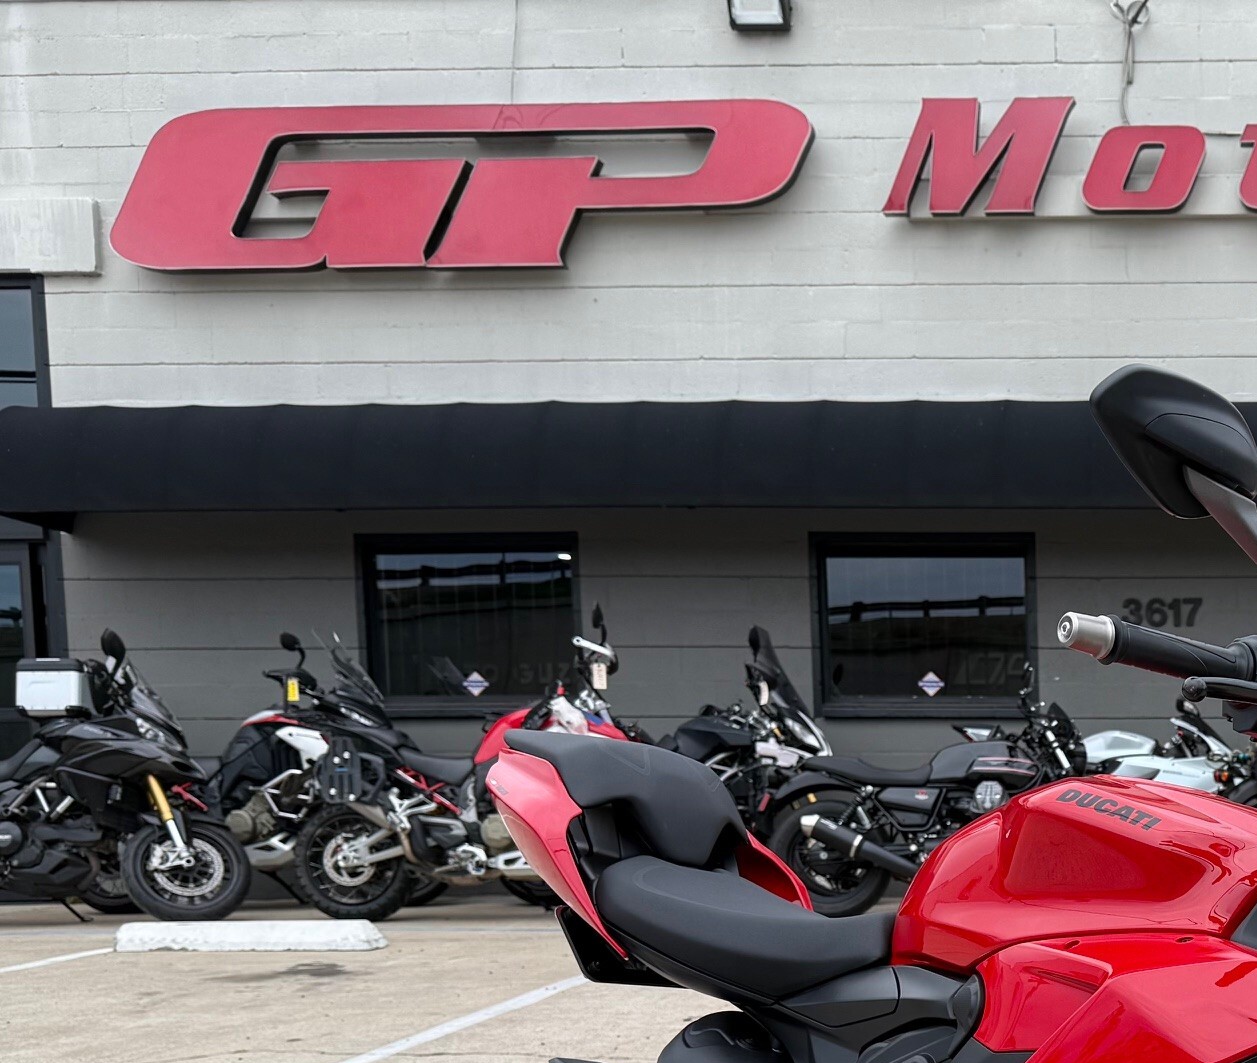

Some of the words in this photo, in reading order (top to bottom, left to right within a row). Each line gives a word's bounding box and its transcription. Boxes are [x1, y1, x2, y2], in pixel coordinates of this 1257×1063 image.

[109, 98, 815, 276] GP
[1121, 597, 1203, 628] 3617
[1056, 788, 1162, 831] DUCATI
